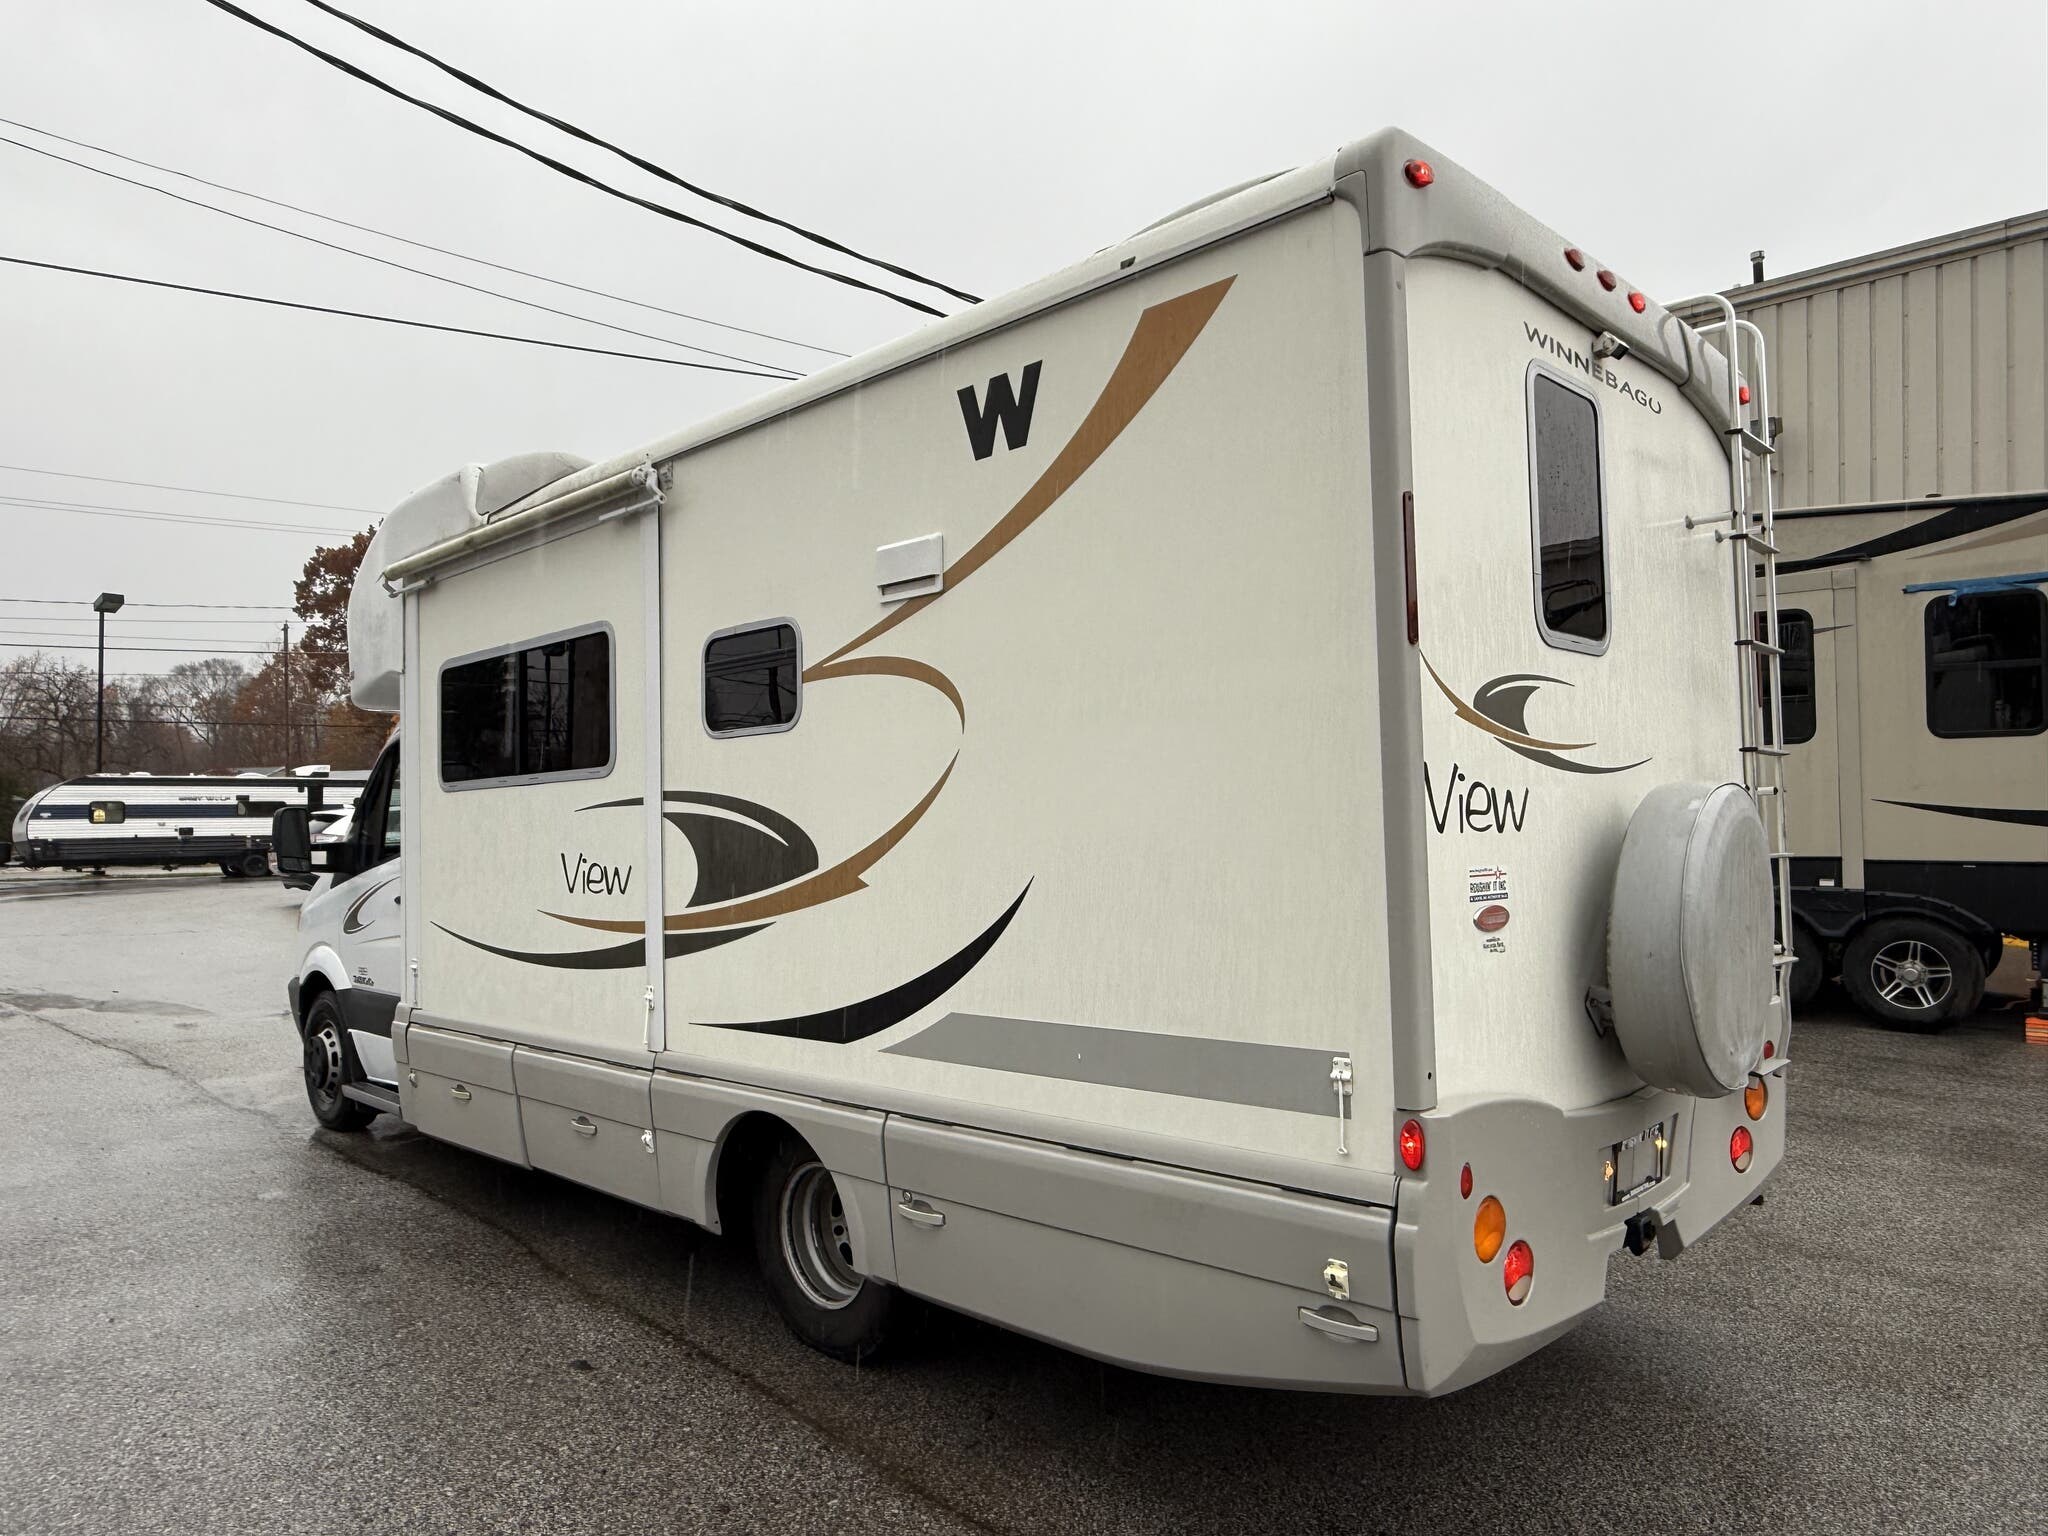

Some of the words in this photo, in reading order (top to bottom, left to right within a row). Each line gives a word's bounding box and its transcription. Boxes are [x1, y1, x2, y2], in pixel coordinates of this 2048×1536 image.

[1523, 320, 1662, 415] WINNEBAGO
[957, 359, 1043, 461] W
[1423, 761, 1530, 834] View
[560, 852, 632, 895] View
